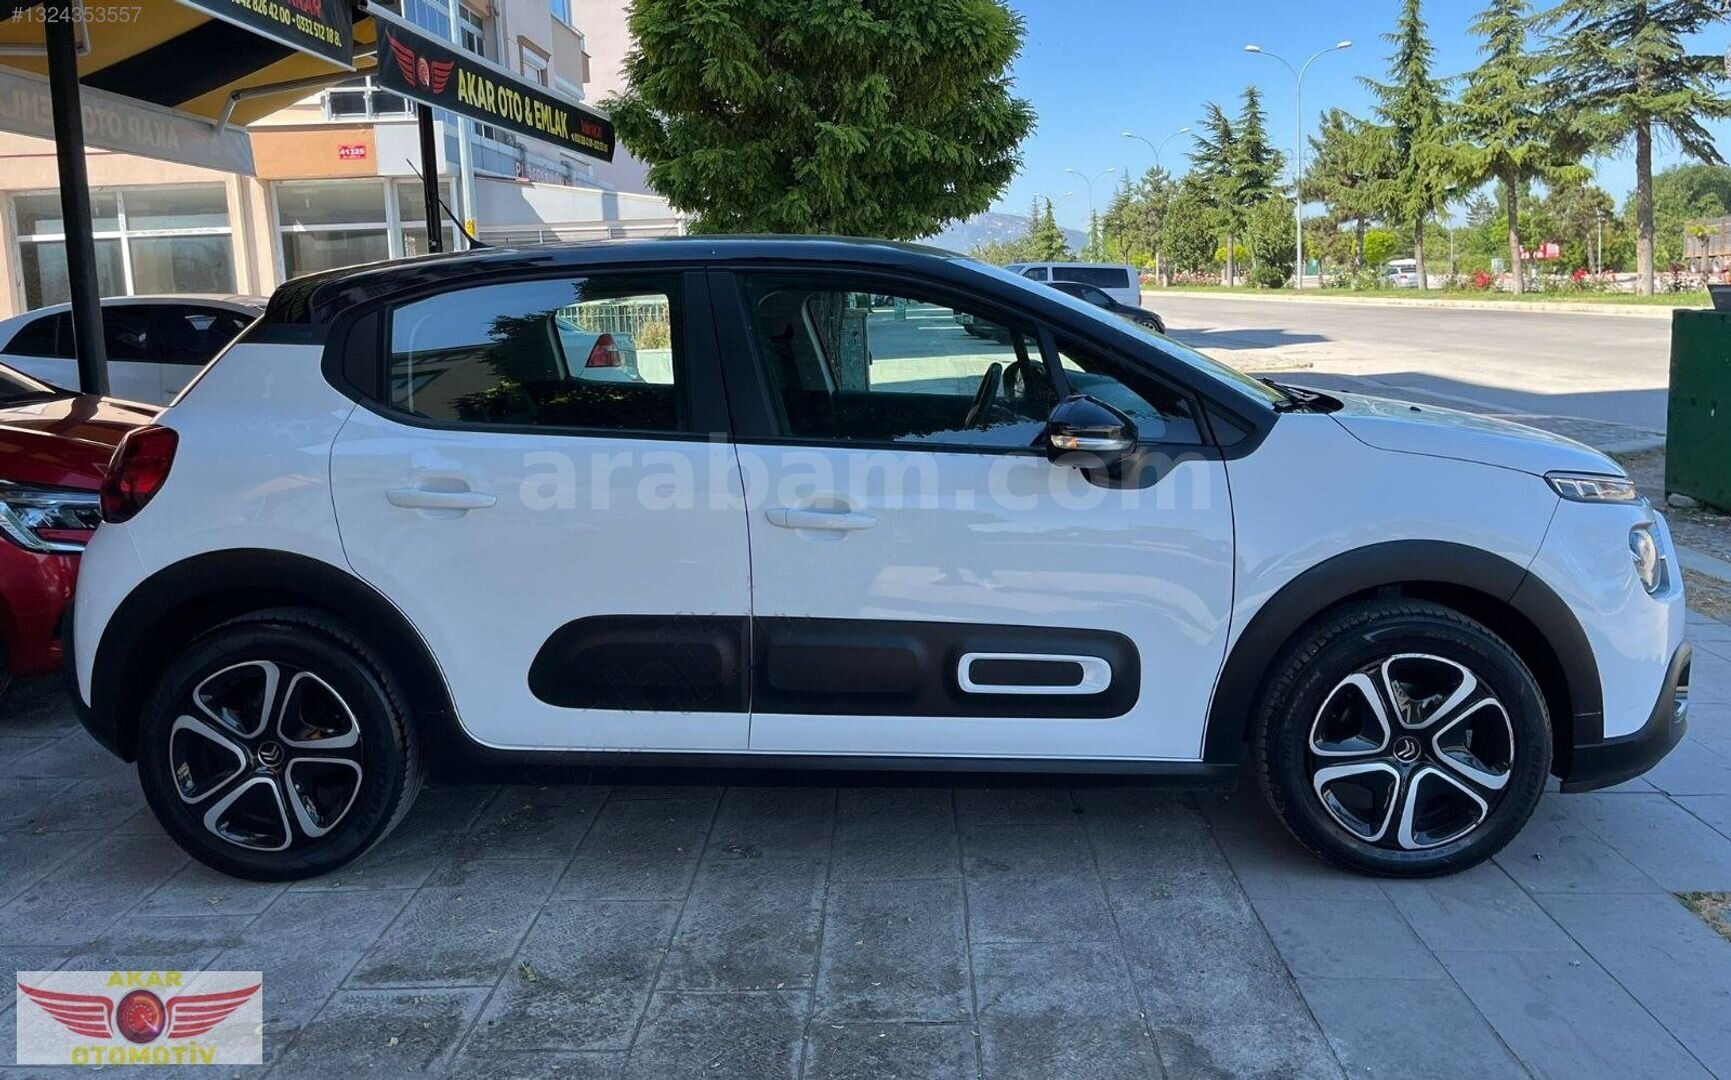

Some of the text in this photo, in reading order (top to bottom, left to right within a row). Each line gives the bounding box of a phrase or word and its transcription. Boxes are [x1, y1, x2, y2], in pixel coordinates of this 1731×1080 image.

[279, 6, 291, 25] 00
[457, 68, 497, 114] AKAR
[497, 85, 523, 123] OTO
[524, 96, 534, 127] &
[533, 100, 569, 140] EMLAK
